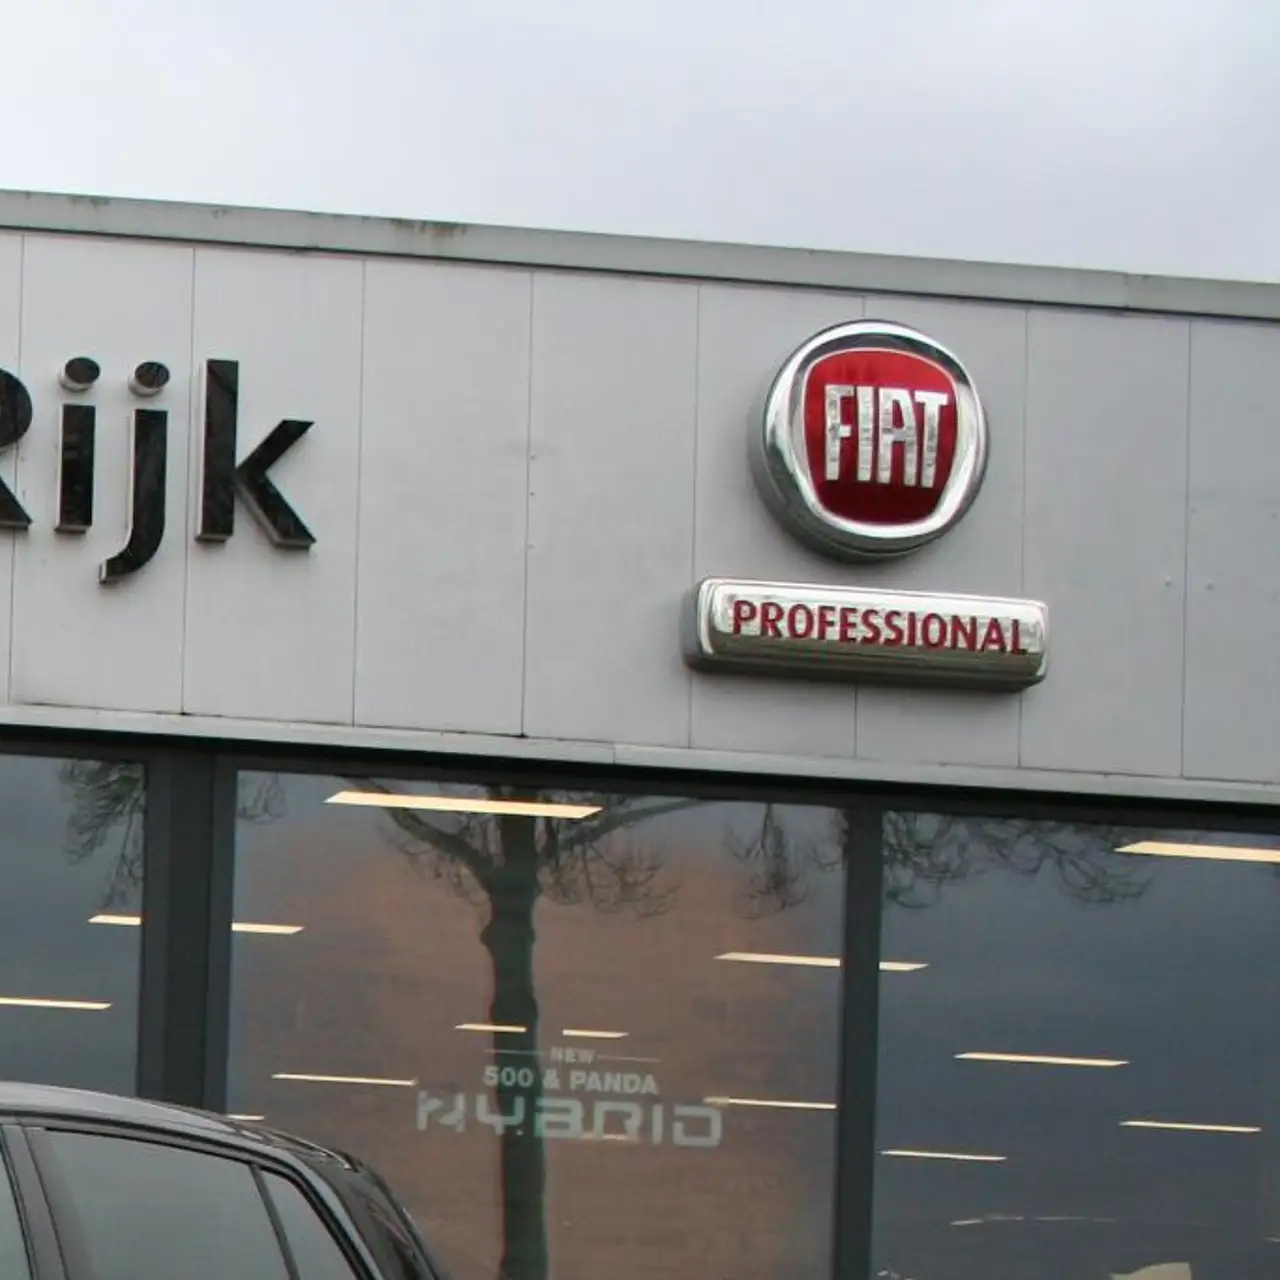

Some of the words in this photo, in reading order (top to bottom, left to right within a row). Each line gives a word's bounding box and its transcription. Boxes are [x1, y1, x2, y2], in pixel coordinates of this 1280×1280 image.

[823, 383, 949, 488] FIAT
[731, 599, 1029, 656] PROFESSIONAL
[483, 1065, 534, 1088] 500
[543, 1070, 561, 1090] &
[569, 1069, 660, 1096] PANDA
[550, 1046, 596, 1063] NEW
[415, 1090, 723, 1147] HYBRID
